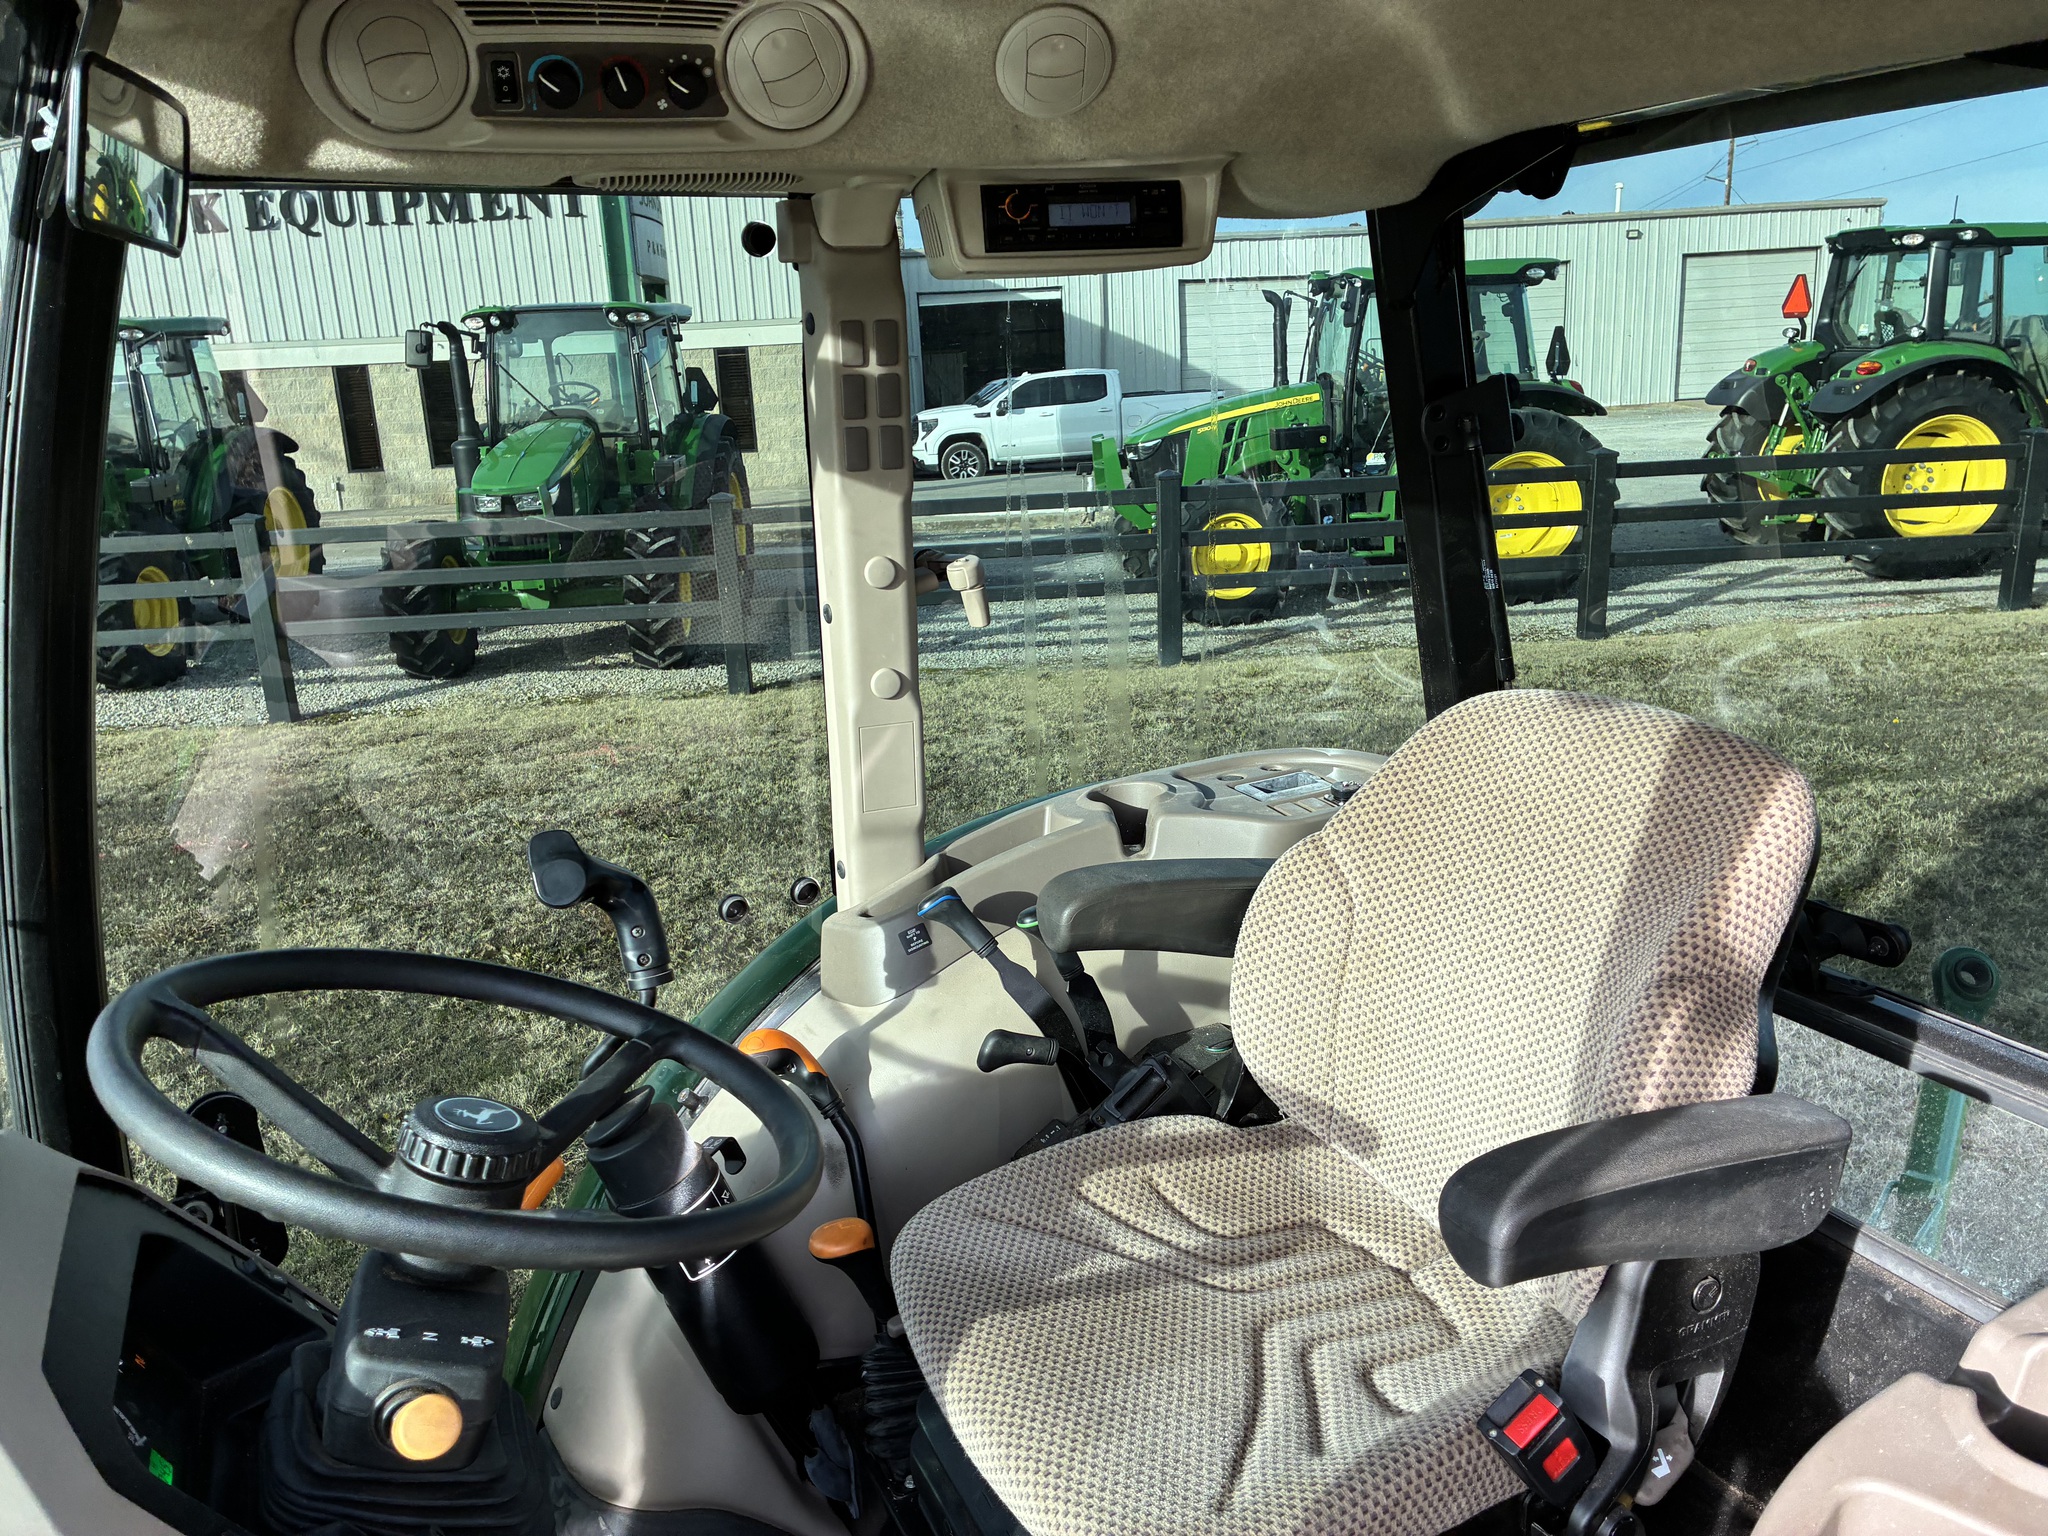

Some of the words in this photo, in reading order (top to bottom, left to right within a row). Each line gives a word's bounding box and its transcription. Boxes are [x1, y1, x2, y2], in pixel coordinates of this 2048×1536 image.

[190, 192, 229, 234] K
[239, 191, 588, 238] EQUIPMENT
[1292, 396, 1313, 404] DEERE
